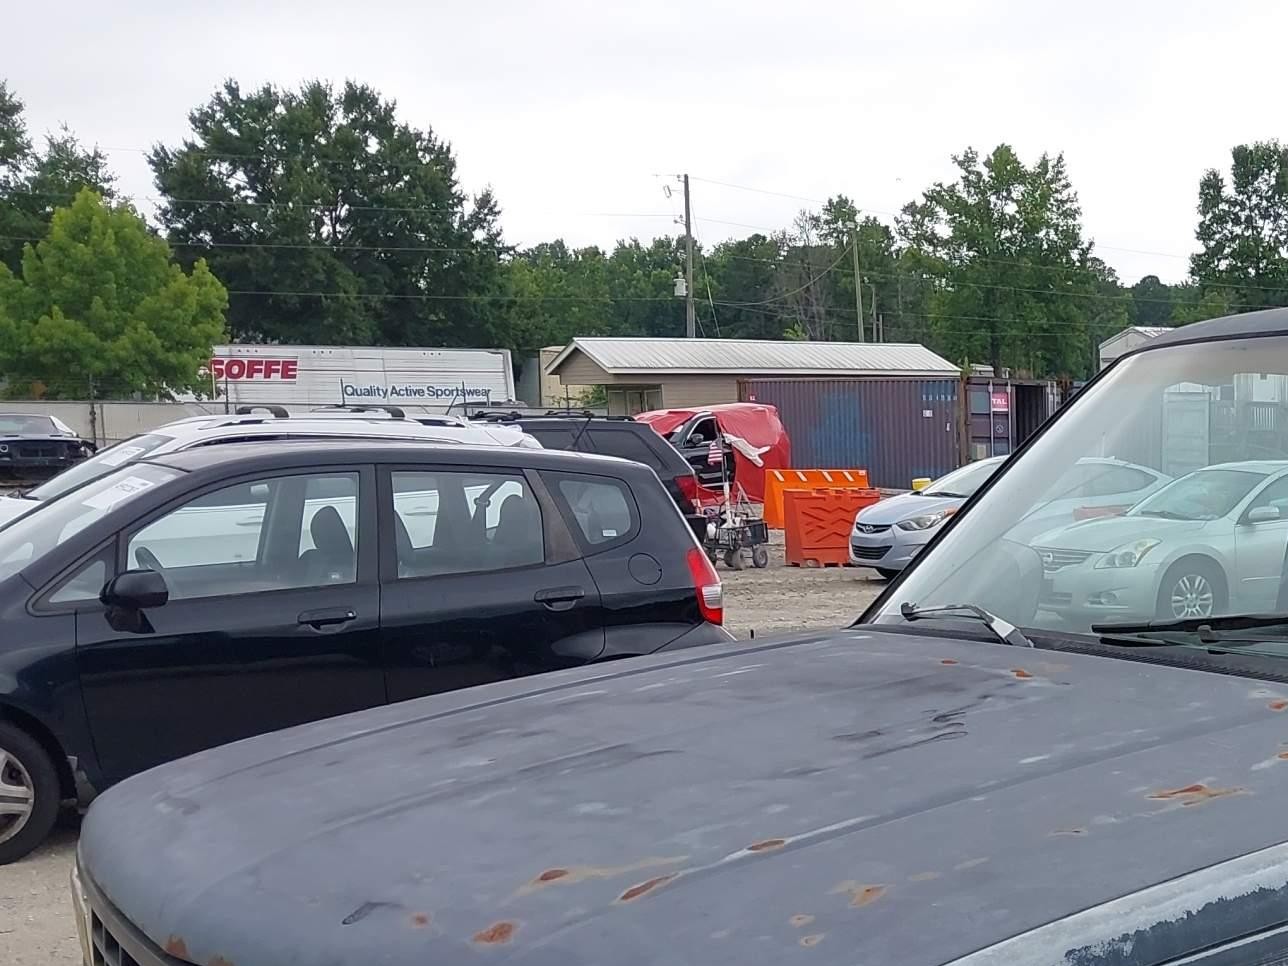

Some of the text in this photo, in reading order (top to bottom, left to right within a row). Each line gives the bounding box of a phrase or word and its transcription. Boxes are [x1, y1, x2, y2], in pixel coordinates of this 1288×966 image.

[209, 359, 298, 380] SOFFE
[344, 384, 491, 399] Quality Active Sportswear
